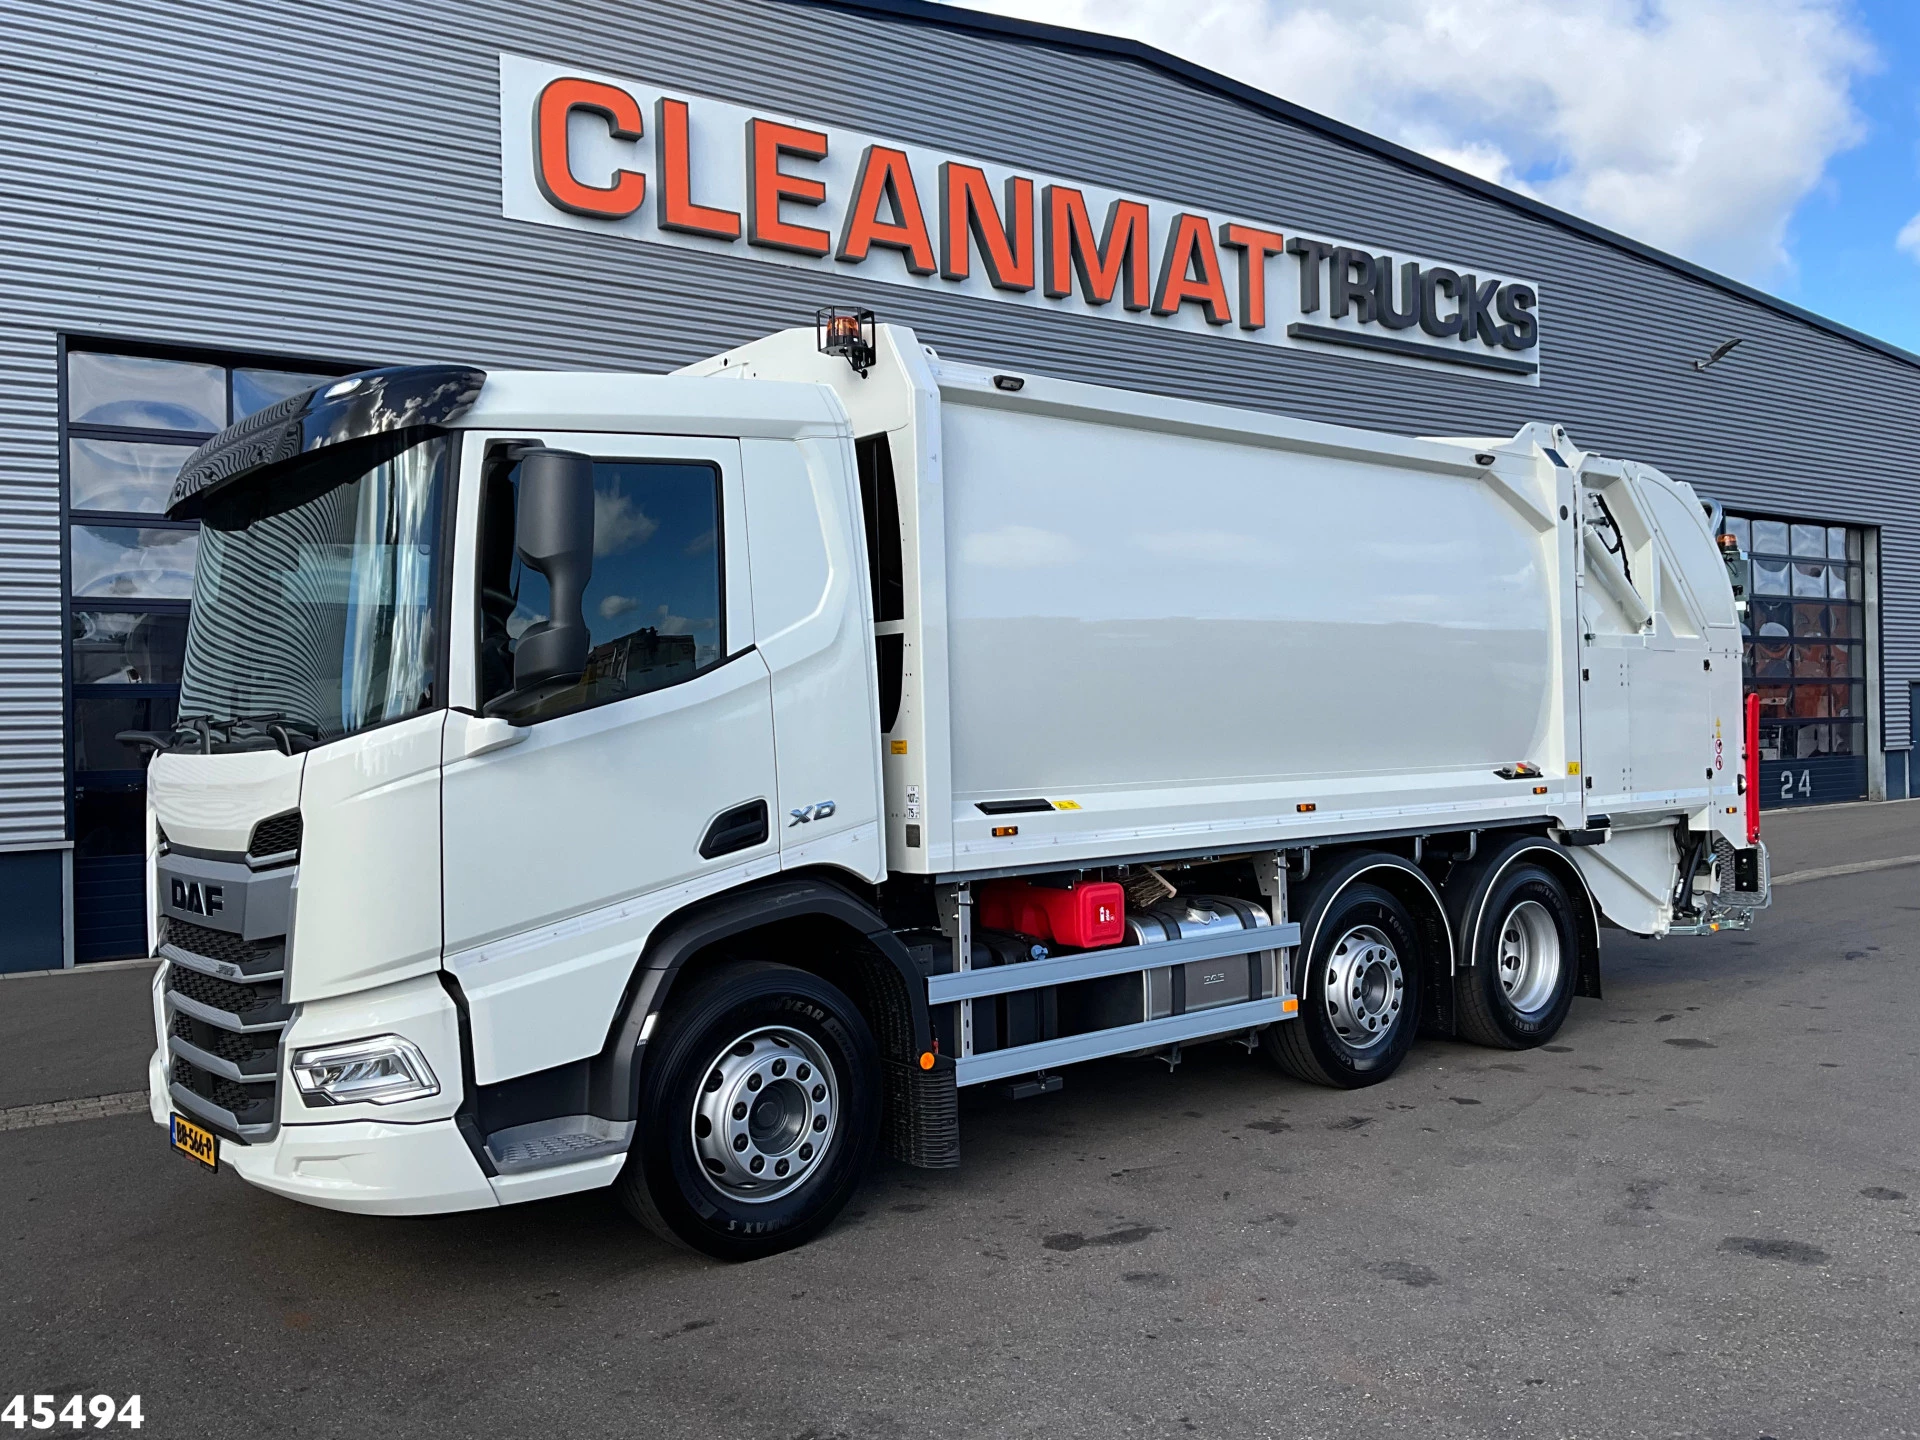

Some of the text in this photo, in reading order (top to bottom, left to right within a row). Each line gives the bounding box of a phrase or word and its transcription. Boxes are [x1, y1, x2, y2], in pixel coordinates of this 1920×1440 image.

[532, 76, 1538, 350] CLEANMAT TRUCKS
[1781, 769, 1811, 799] 24
[788, 800, 836, 828] XD
[171, 877, 224, 917] DAF
